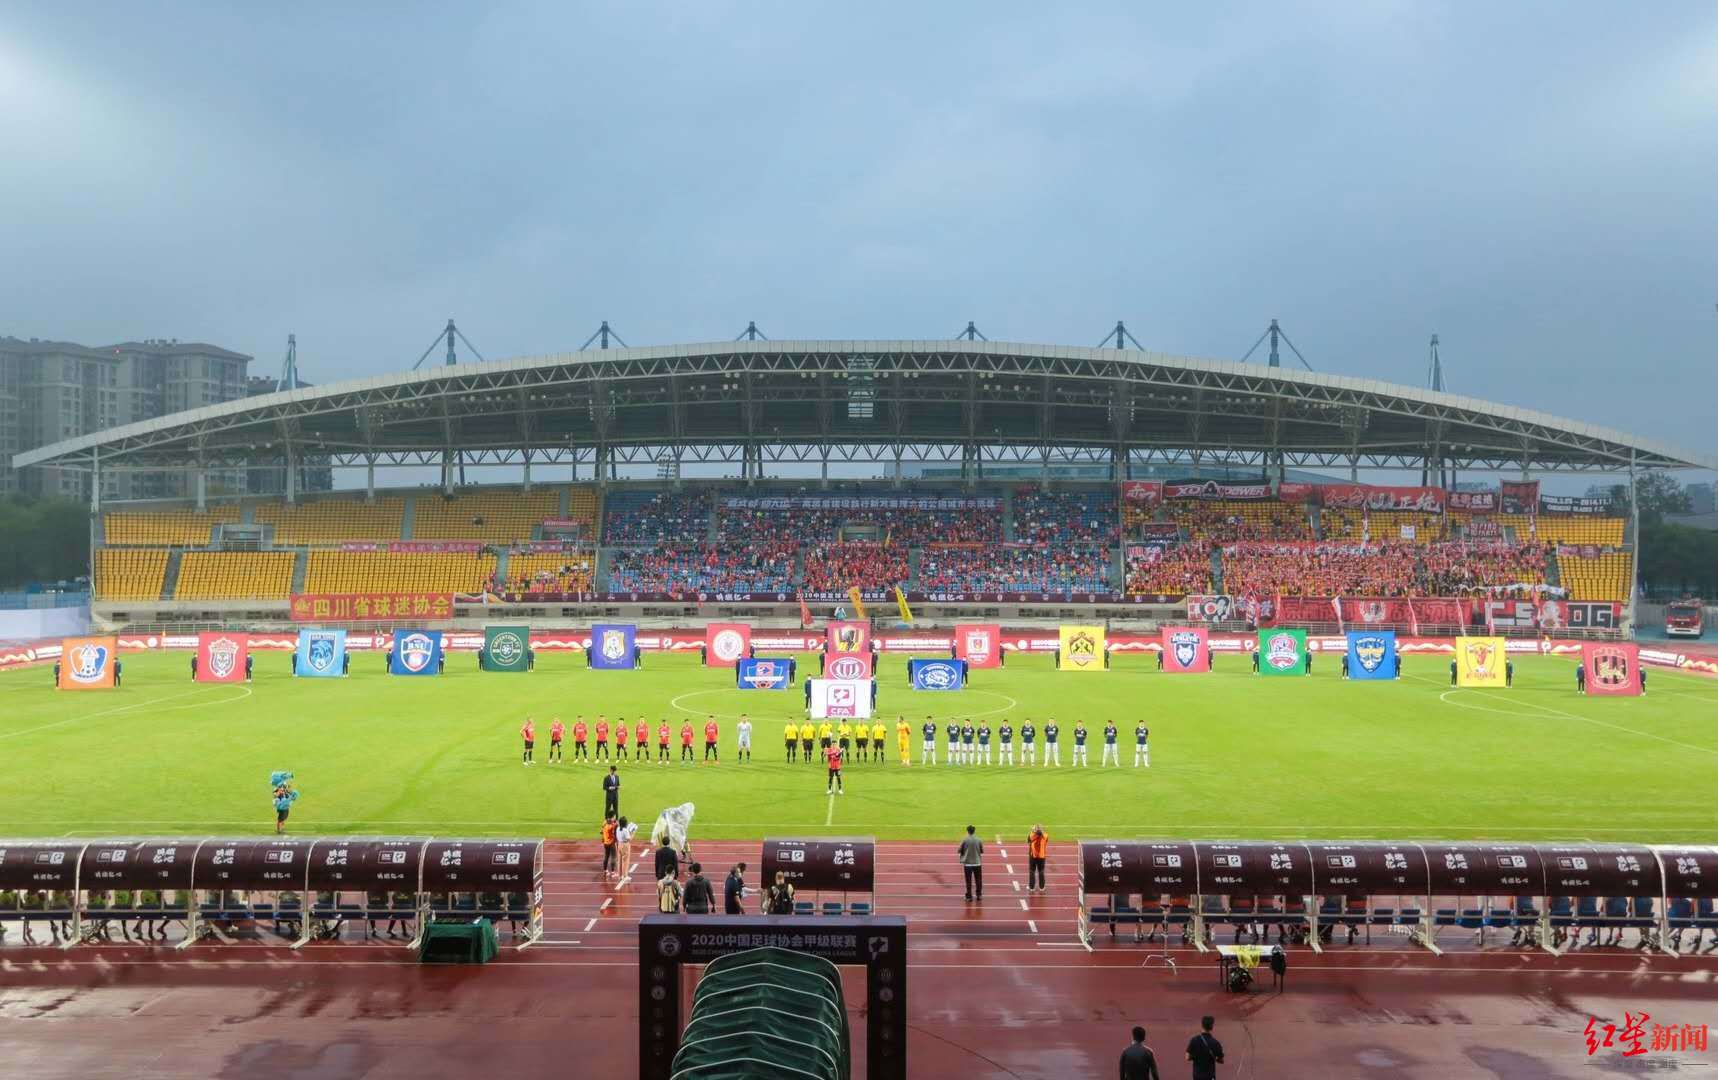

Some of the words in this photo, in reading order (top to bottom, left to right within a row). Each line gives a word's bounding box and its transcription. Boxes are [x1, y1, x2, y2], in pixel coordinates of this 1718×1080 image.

[1223, 487, 1266, 497] POWER
[313, 598, 449, 618] 四川省球迷协会
[691, 934, 857, 947] 2020中国足球协会甲级联赛
